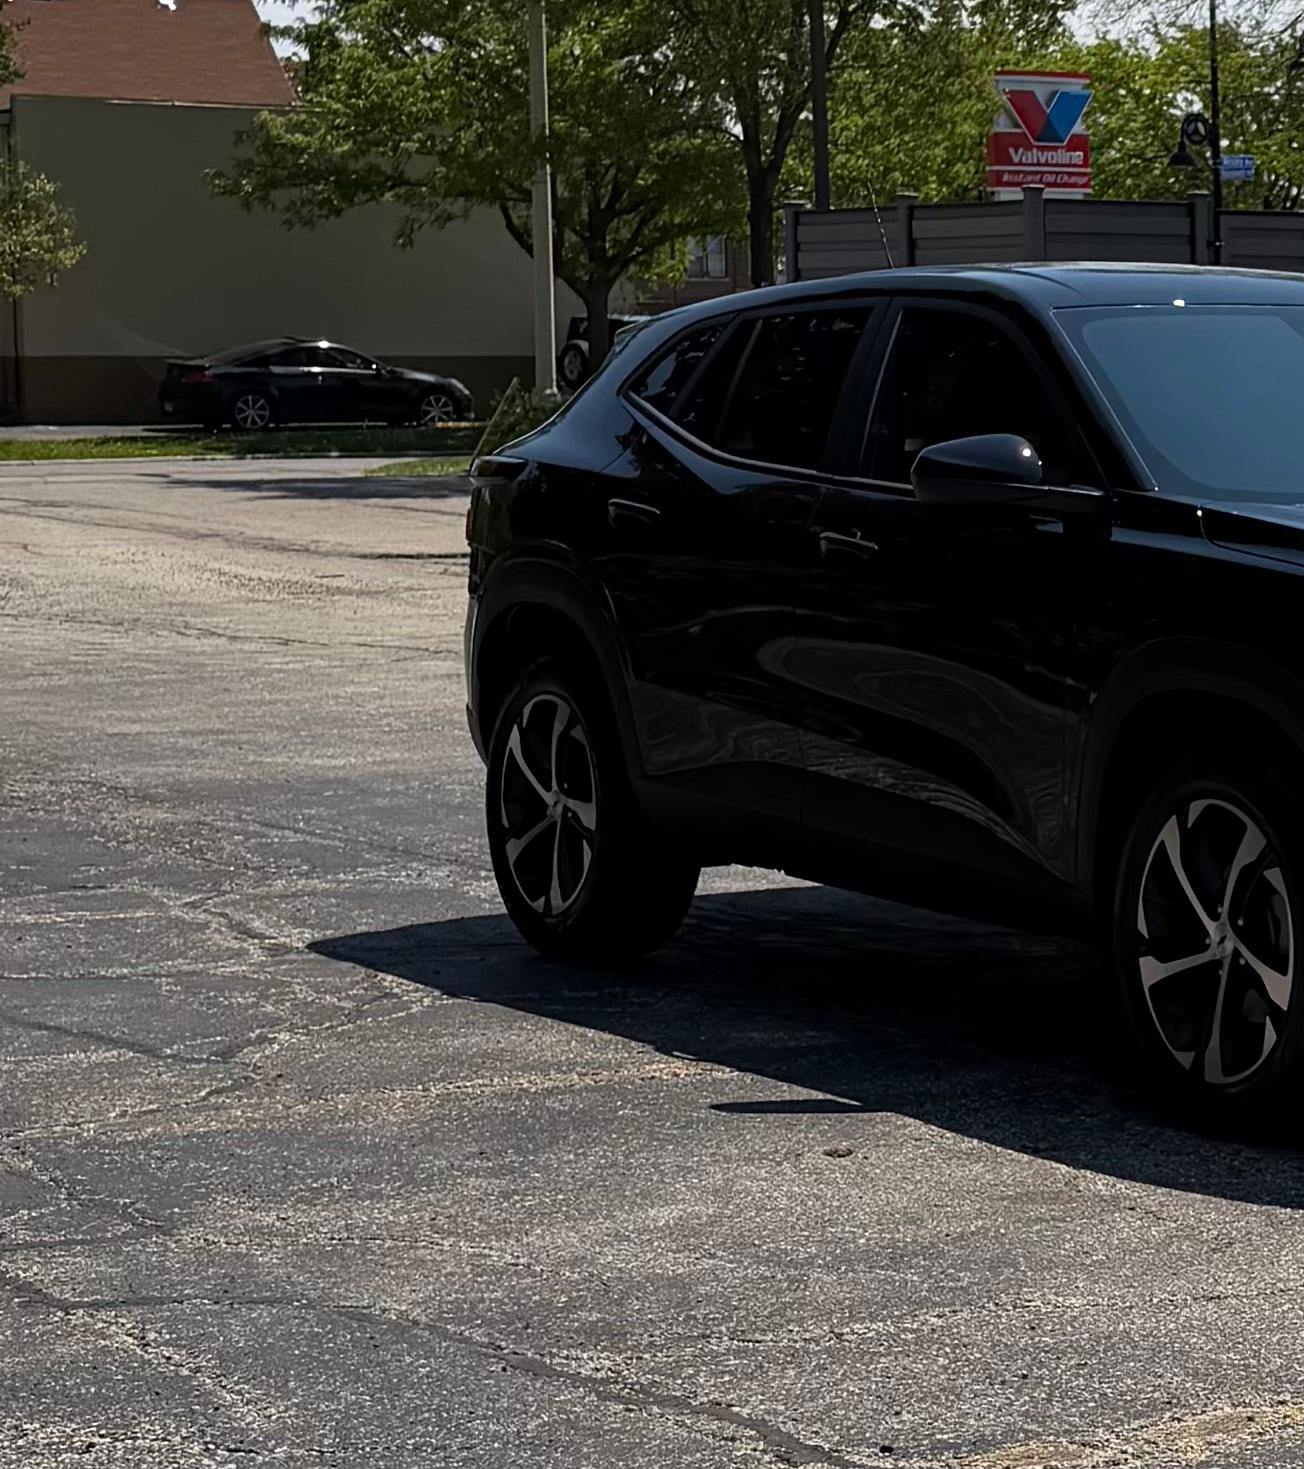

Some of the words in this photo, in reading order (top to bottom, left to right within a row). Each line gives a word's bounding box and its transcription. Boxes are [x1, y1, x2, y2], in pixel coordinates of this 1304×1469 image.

[1008, 147, 1084, 165] Valvoline
[1002, 172, 1040, 183] Instant
[1042, 173, 1056, 184] Oil
[1057, 174, 1089, 185] Change
